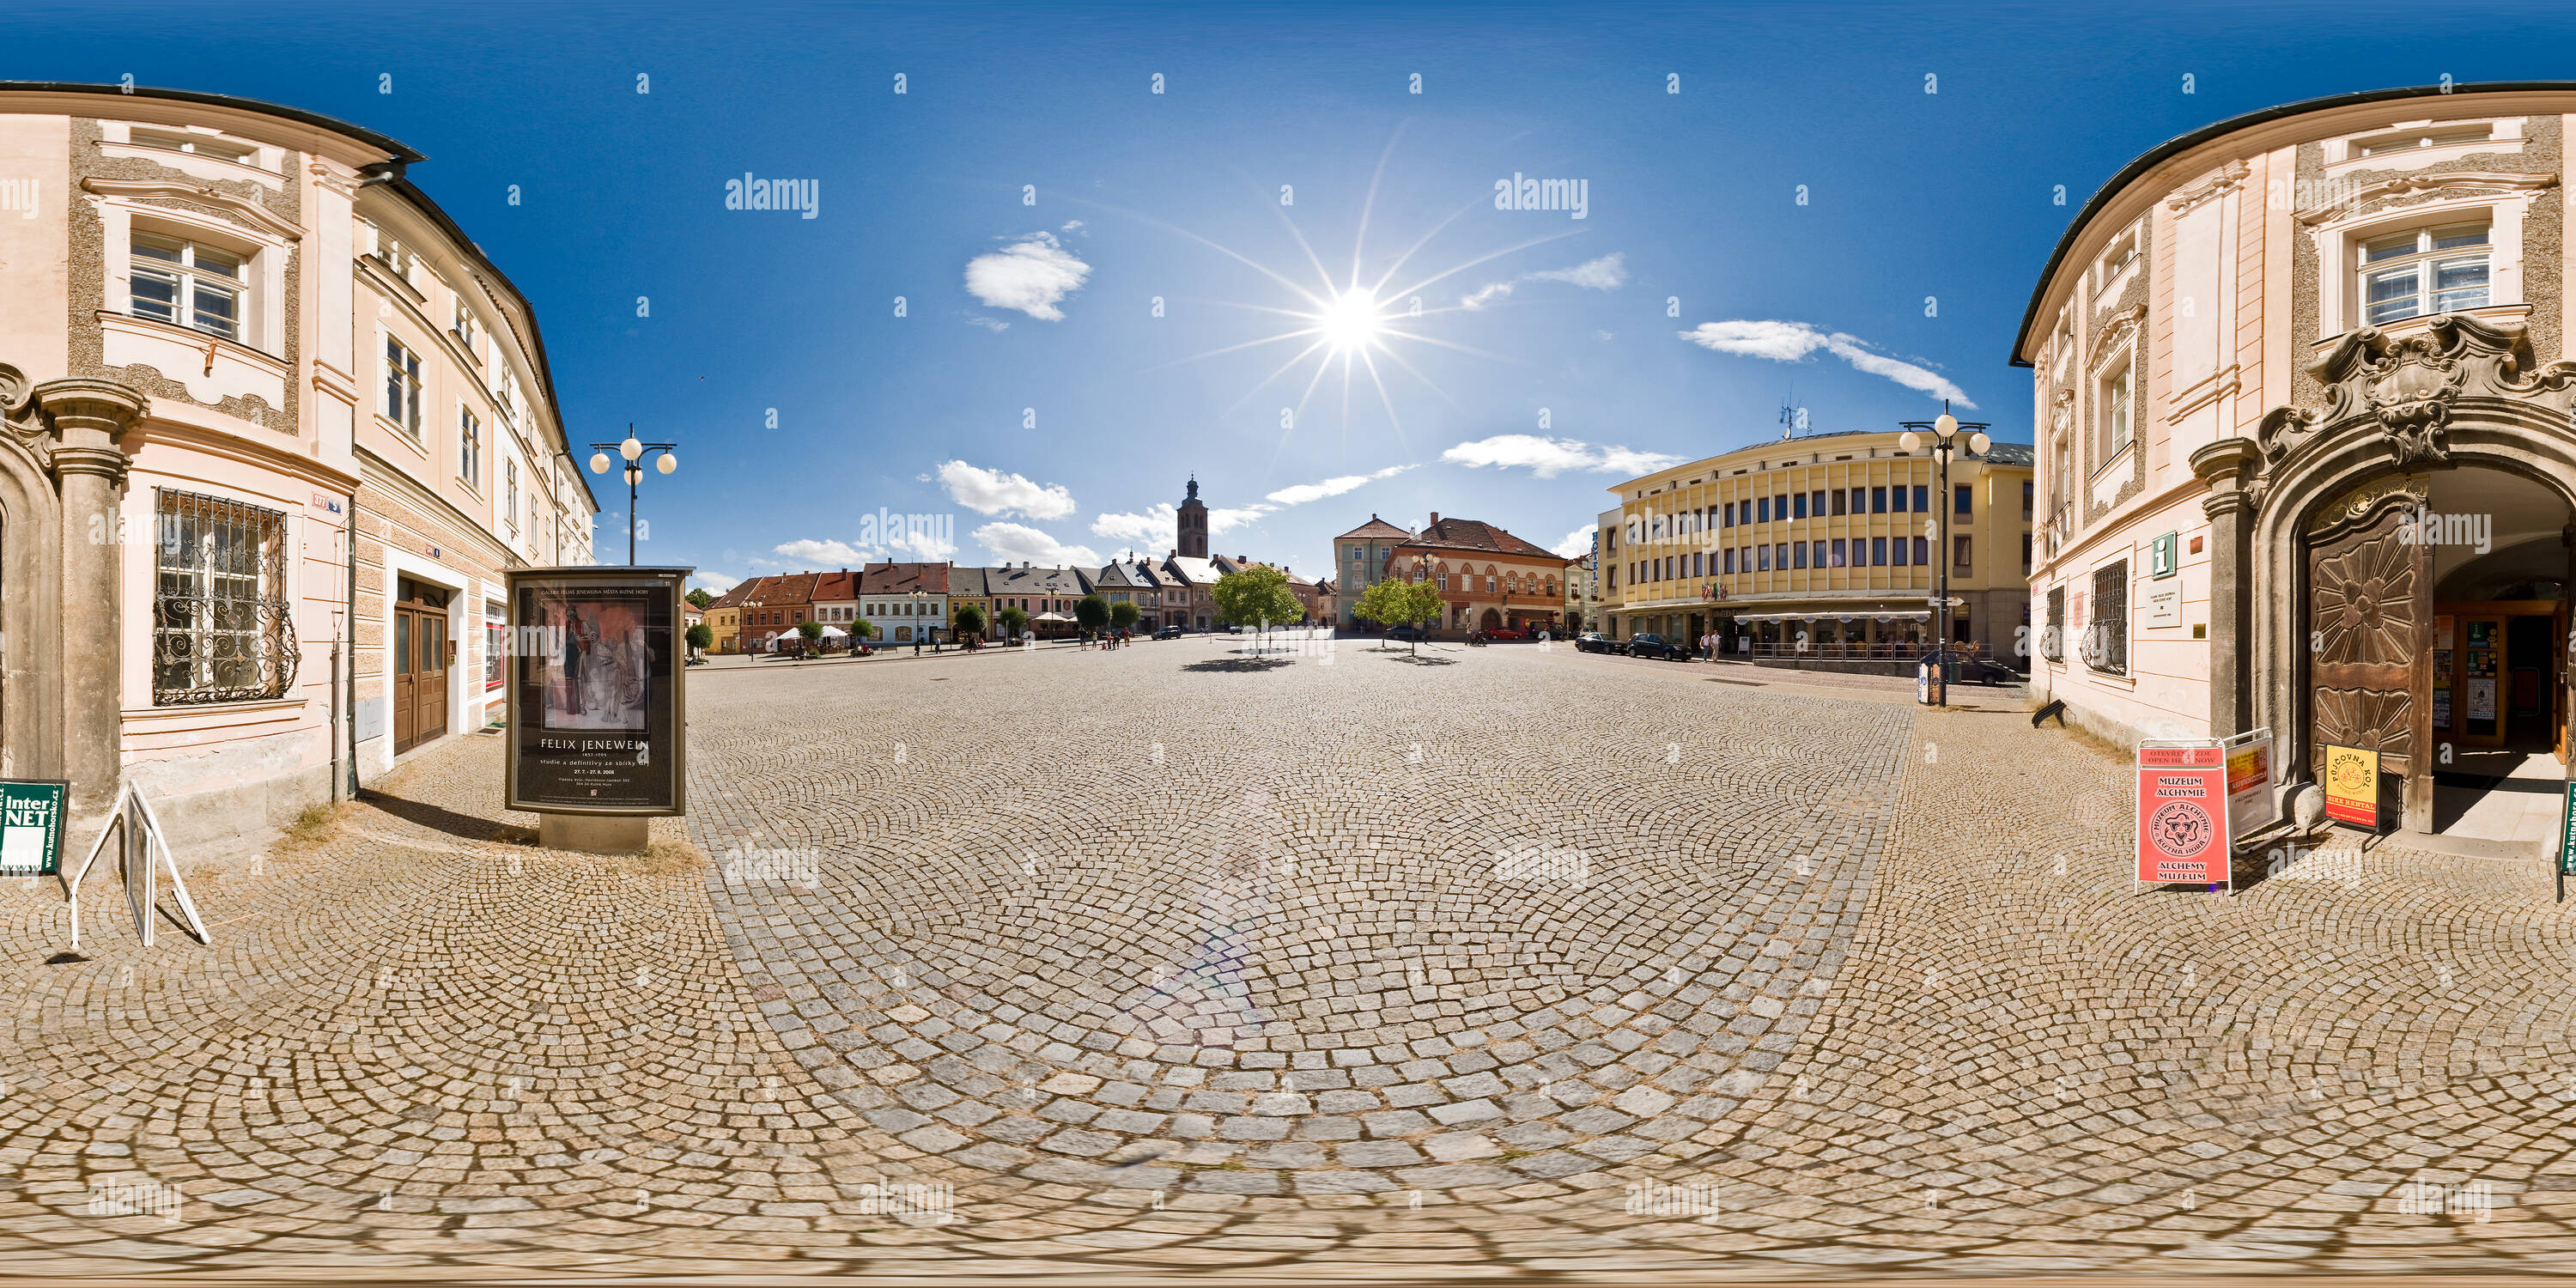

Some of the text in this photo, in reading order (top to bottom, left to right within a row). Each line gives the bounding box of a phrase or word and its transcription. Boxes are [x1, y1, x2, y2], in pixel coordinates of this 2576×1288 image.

[314, 495, 326, 507] 377
[332, 502, 338, 512] 5
[541, 738, 648, 752] FELIX JENEWEIN
[2159, 776, 2203, 786] MUZEUM
[2362, 769, 2372, 788] KOL
[2156, 788, 2206, 797] ALCHYMIE
[2327, 795, 2375, 810] BIKE RENTAL
[4, 810, 50, 826] NET
[2154, 804, 2209, 833] MUZEUM ALCHYMIE
[46, 789, 59, 868] www.kutnohorsko.cz
[2185, 840, 2205, 854] HORA
[2158, 861, 2207, 870] ALCHEMY
[2158, 872, 2207, 881] MUSEUM
